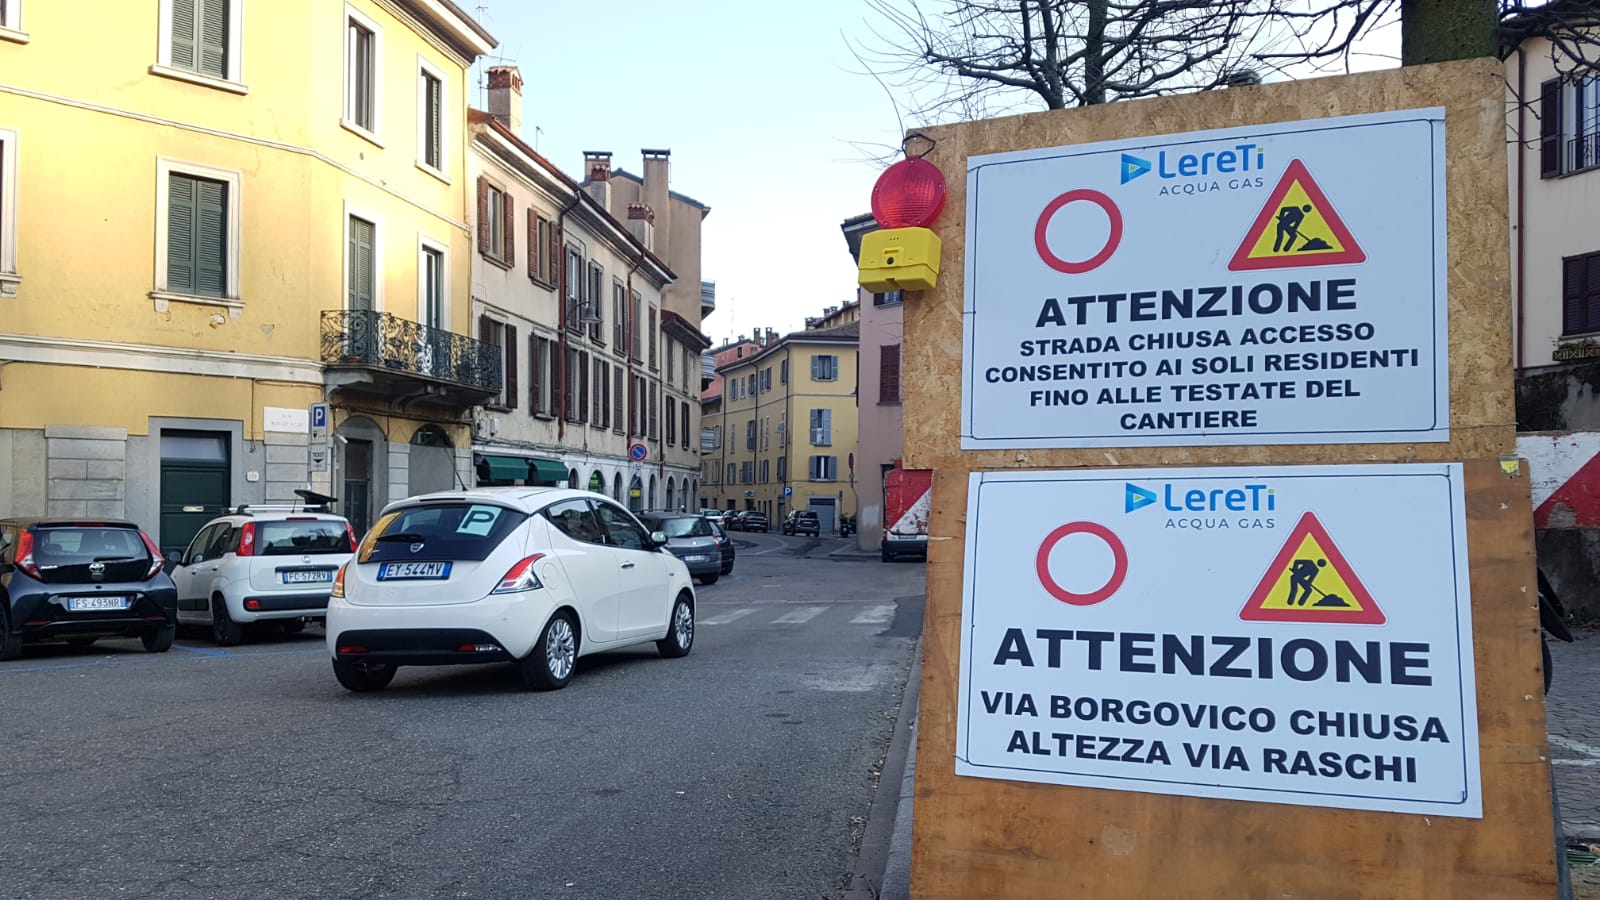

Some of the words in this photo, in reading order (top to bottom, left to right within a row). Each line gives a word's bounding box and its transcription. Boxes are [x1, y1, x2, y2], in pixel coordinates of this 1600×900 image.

[1159, 144, 1264, 178] LereTi
[1159, 181, 1220, 196] ACQUA
[1228, 177, 1264, 190] GAS
[1036, 279, 1357, 328] ATTENZIONE
[1020, 336, 1121, 357] STRADA
[1128, 330, 1232, 351] CHIUSA
[1239, 323, 1375, 346] ACCESSO
[985, 360, 1147, 384] CONSENTITO
[1155, 358, 1182, 377] AI
[1191, 356, 1254, 375] SOLI
[1264, 349, 1419, 372] RESIDENTI
[1030, 389, 1089, 407] FINO
[1097, 386, 1162, 405] ALLE
[1170, 381, 1296, 403] TESTATE
[1306, 380, 1361, 399] DEL
[1120, 410, 1258, 431] CANTIERE
[1164, 483, 1276, 512] LereTi
[461, 510, 495, 529] P
[1164, 518, 1230, 530] ACQUA
[1238, 518, 1276, 529] GAS
[993, 627, 1433, 687] ATTENZIONE
[980, 690, 1039, 718] VIA
[1051, 695, 1276, 733] BORGOVICO
[1289, 709, 1450, 744] CHIUSA
[1006, 730, 1172, 766] ALTEZZA
[1182, 742, 1250, 772] VIA
[1263, 747, 1417, 784] RASCHI
